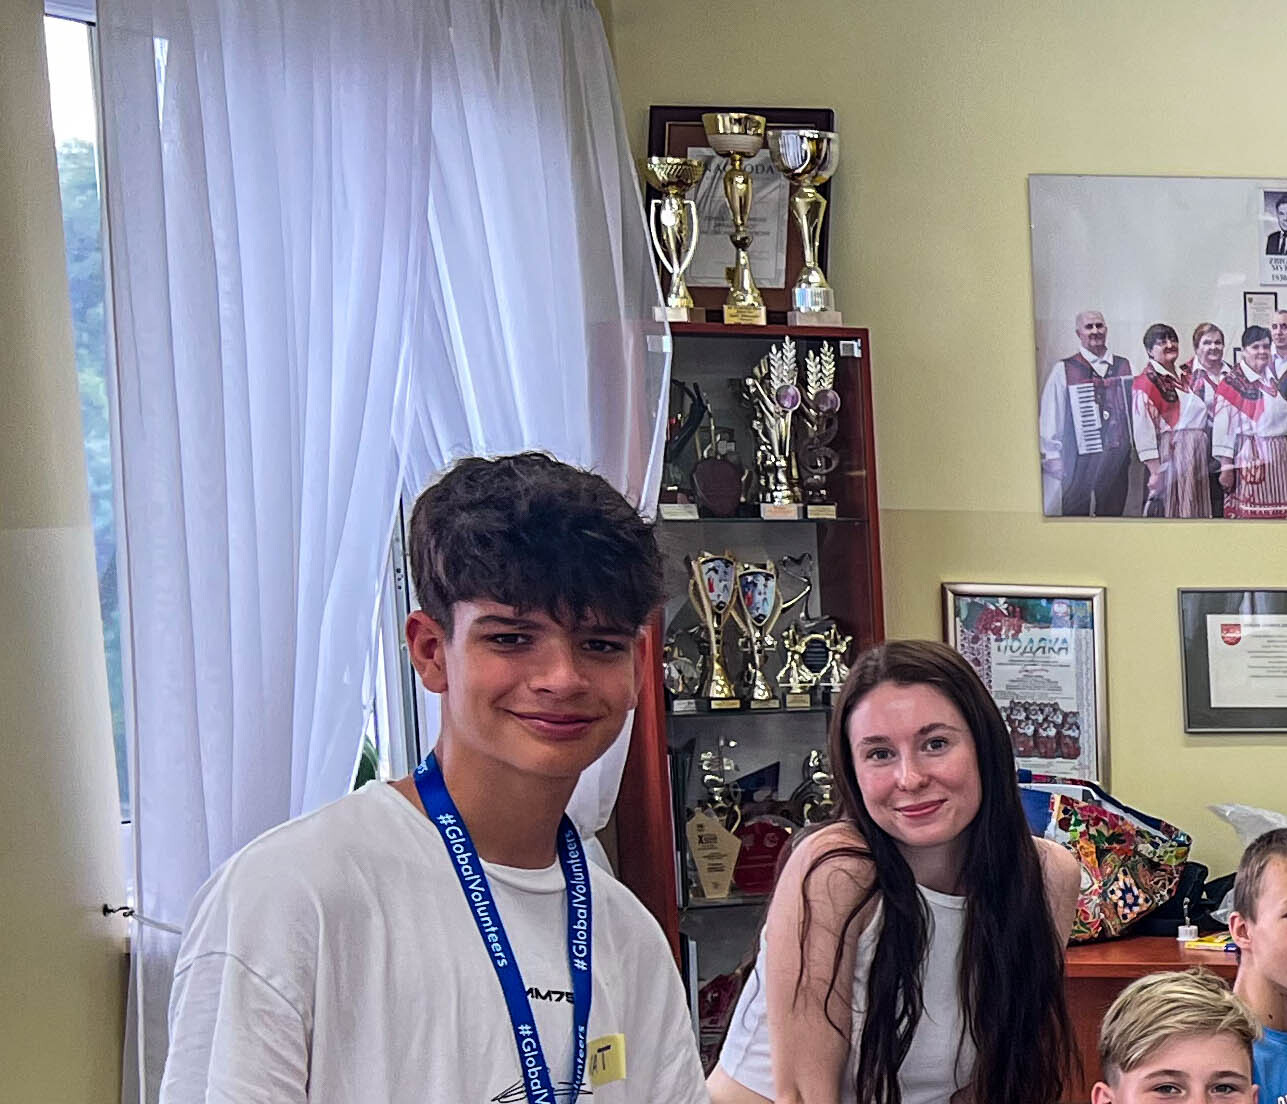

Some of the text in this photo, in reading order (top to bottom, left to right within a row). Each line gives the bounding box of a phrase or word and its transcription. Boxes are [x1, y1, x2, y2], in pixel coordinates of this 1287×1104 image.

[997, 636, 1069, 656] ПОДЯКА
[437, 813, 508, 968] #GlobalVolunteers
[564, 829, 588, 971] #GlobalVolunteers
